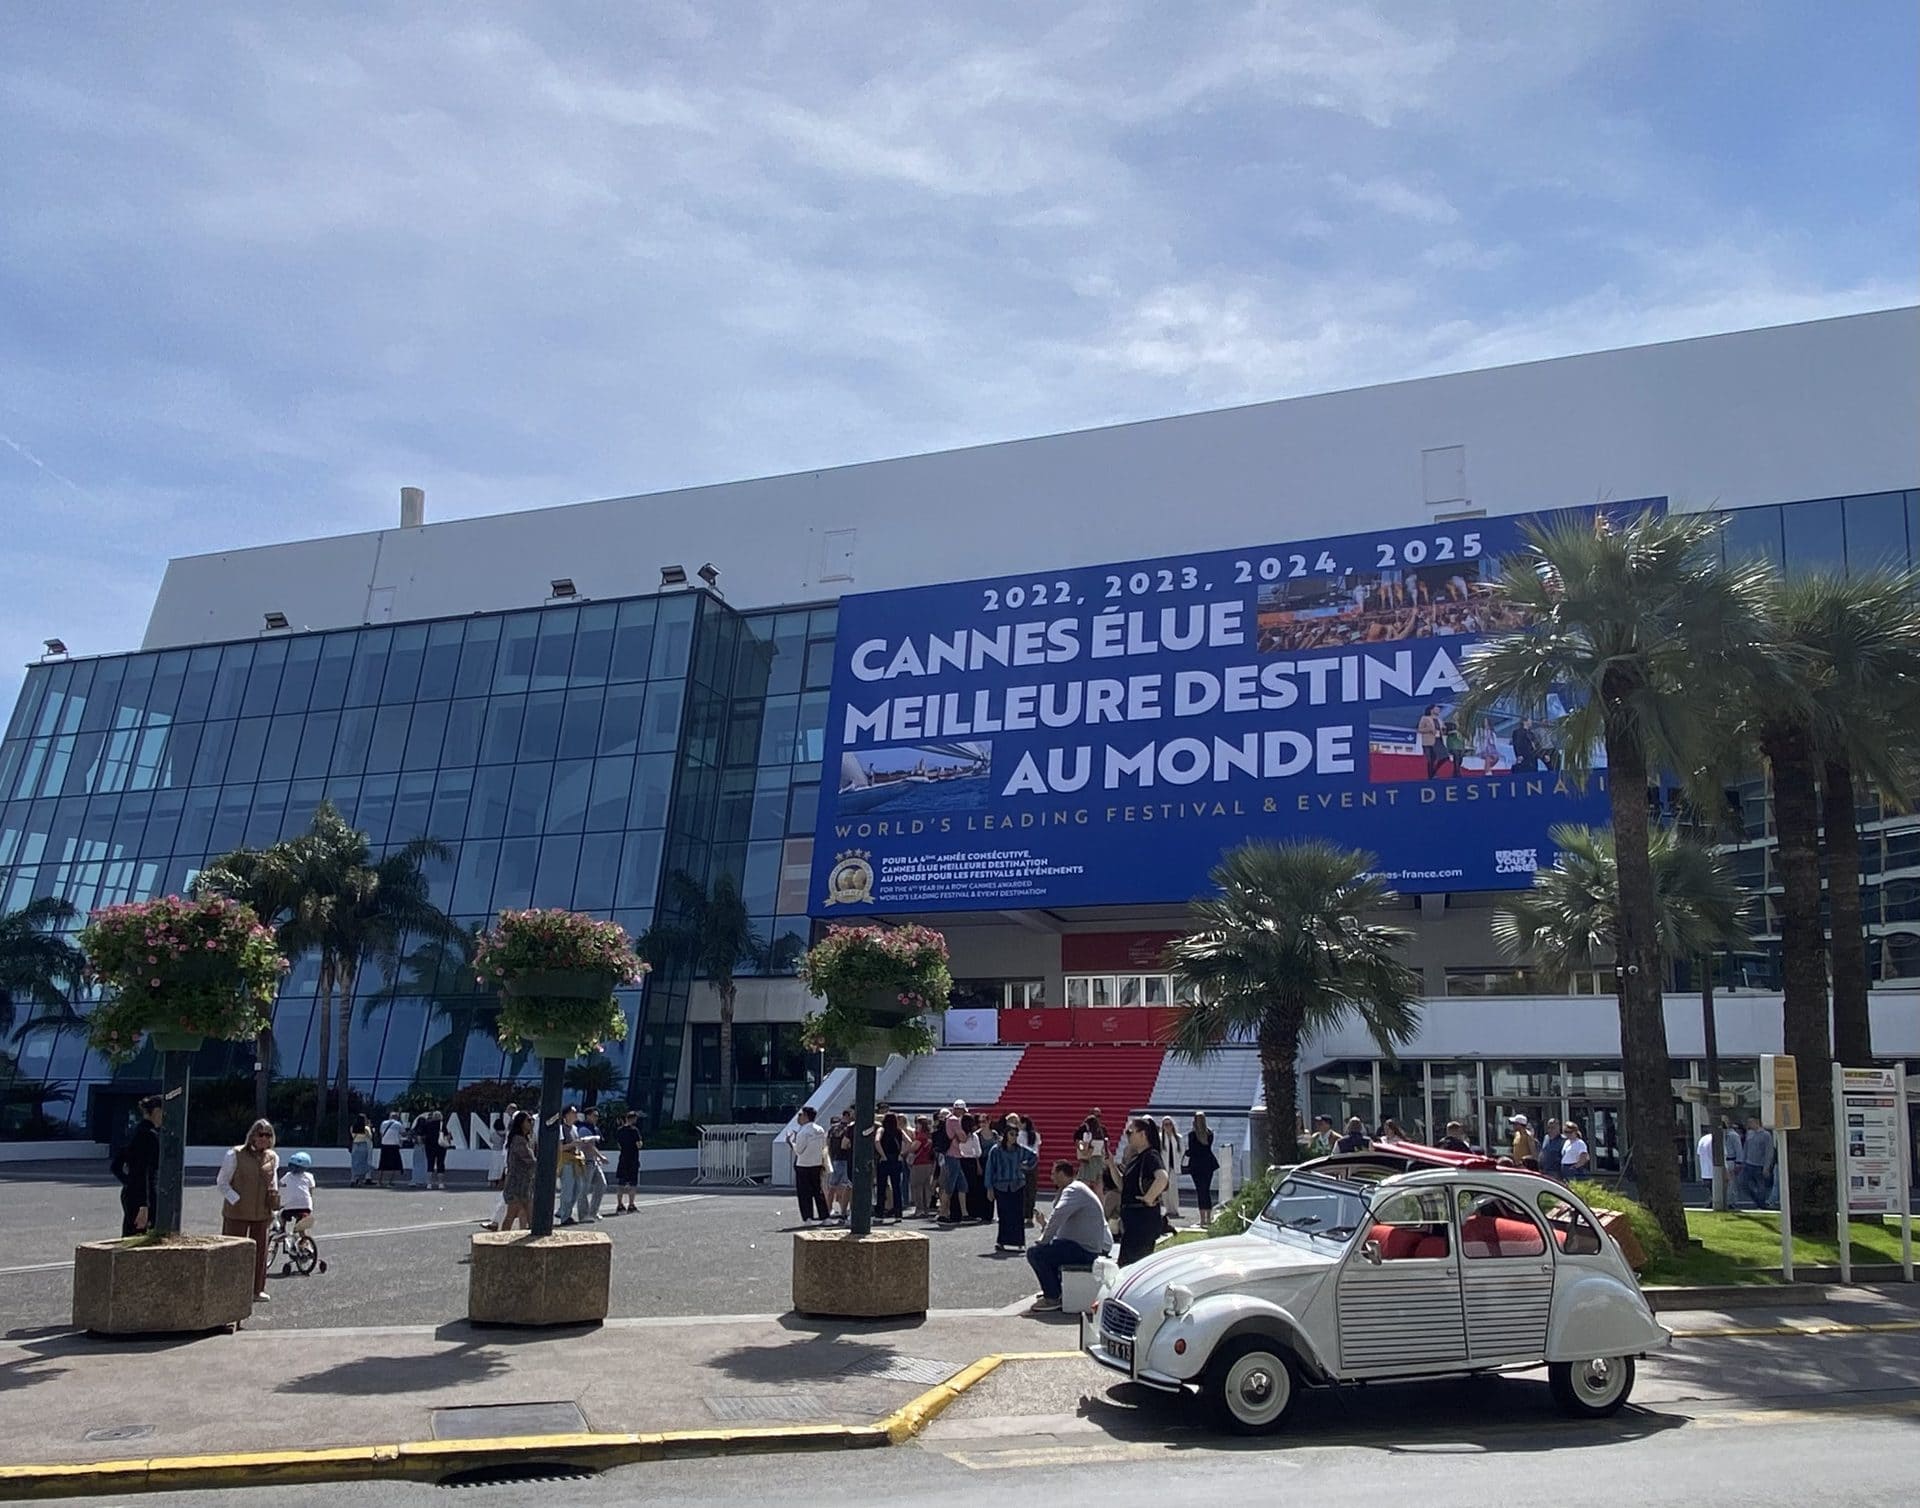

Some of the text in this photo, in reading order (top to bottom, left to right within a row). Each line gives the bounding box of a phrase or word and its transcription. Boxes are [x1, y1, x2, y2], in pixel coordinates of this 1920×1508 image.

[983, 533, 1483, 611] 2022, 2023, 2024, 2025
[850, 600, 1245, 682] CANNES ÉLUE
[842, 644, 1477, 744] MEILLEURE DESTINA
[1001, 725, 1355, 797] AU MONDE
[834, 818, 952, 838] WORLD'S
[967, 809, 1089, 831] LEADING
[1106, 800, 1245, 823] FESTIVAL
[1263, 797, 1278, 812] &
[1297, 789, 1399, 811] EVENT
[882, 856, 907, 865] POUR
[908, 856, 919, 864] LA
[937, 851, 966, 862] ANNÉE
[1496, 856, 1527, 865] VOUS
[881, 858, 1048, 874] CANNES ÉLUE MEILLEURE DESTINATION
[1495, 863, 1538, 873] CANNES
[881, 874, 893, 882] AU
[894, 873, 927, 882] MONDE
[927, 872, 952, 881] POUR
[953, 871, 969, 879] LES
[969, 868, 1015, 879] FESTIVALS
[968, 881, 997, 889] CANNES
[997, 880, 1033, 888] AWARDED
[910, 892, 940, 900] LEADING
[940, 891, 969, 899] FESTIVAL
[999, 888, 1047, 897] DESTINATION
